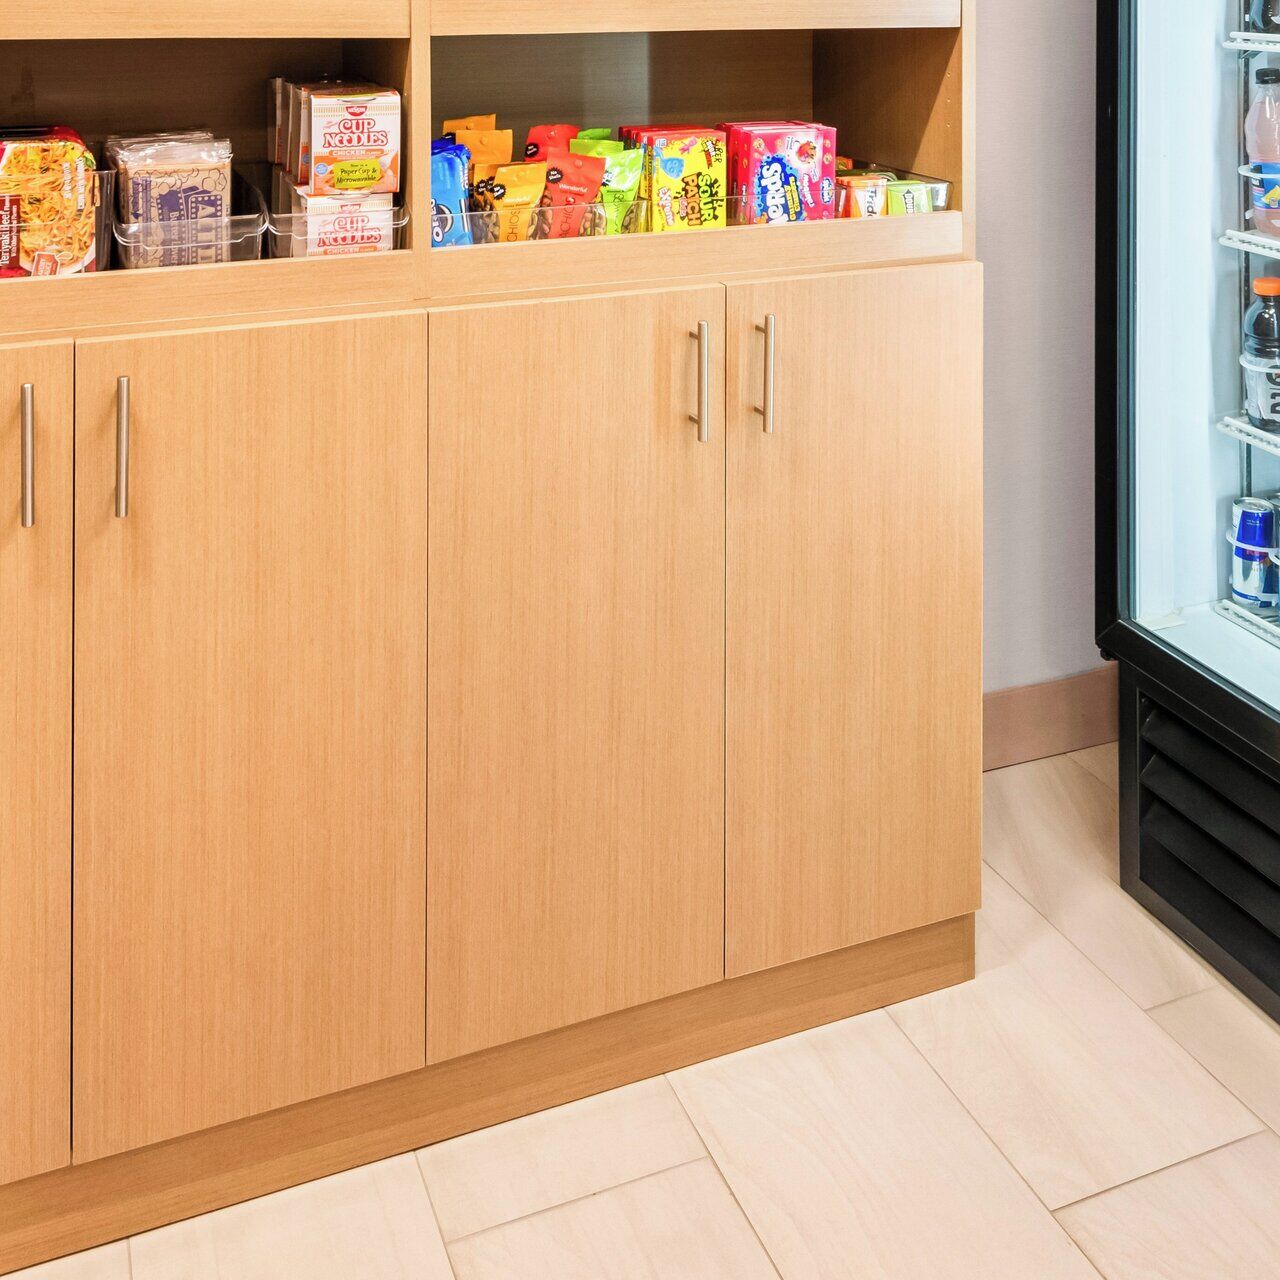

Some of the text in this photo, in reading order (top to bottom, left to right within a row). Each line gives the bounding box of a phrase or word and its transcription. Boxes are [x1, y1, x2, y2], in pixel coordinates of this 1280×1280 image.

[338, 118, 375, 133] CUP
[323, 132, 389, 148] NOODLES
[340, 168, 358, 176] Paper
[558, 183, 588, 192] Wonderful
[682, 174, 702, 226] PATCH
[698, 174, 713, 222] SOUR
[334, 217, 369, 231] CUP
[318, 229, 381, 247] NOODLES
